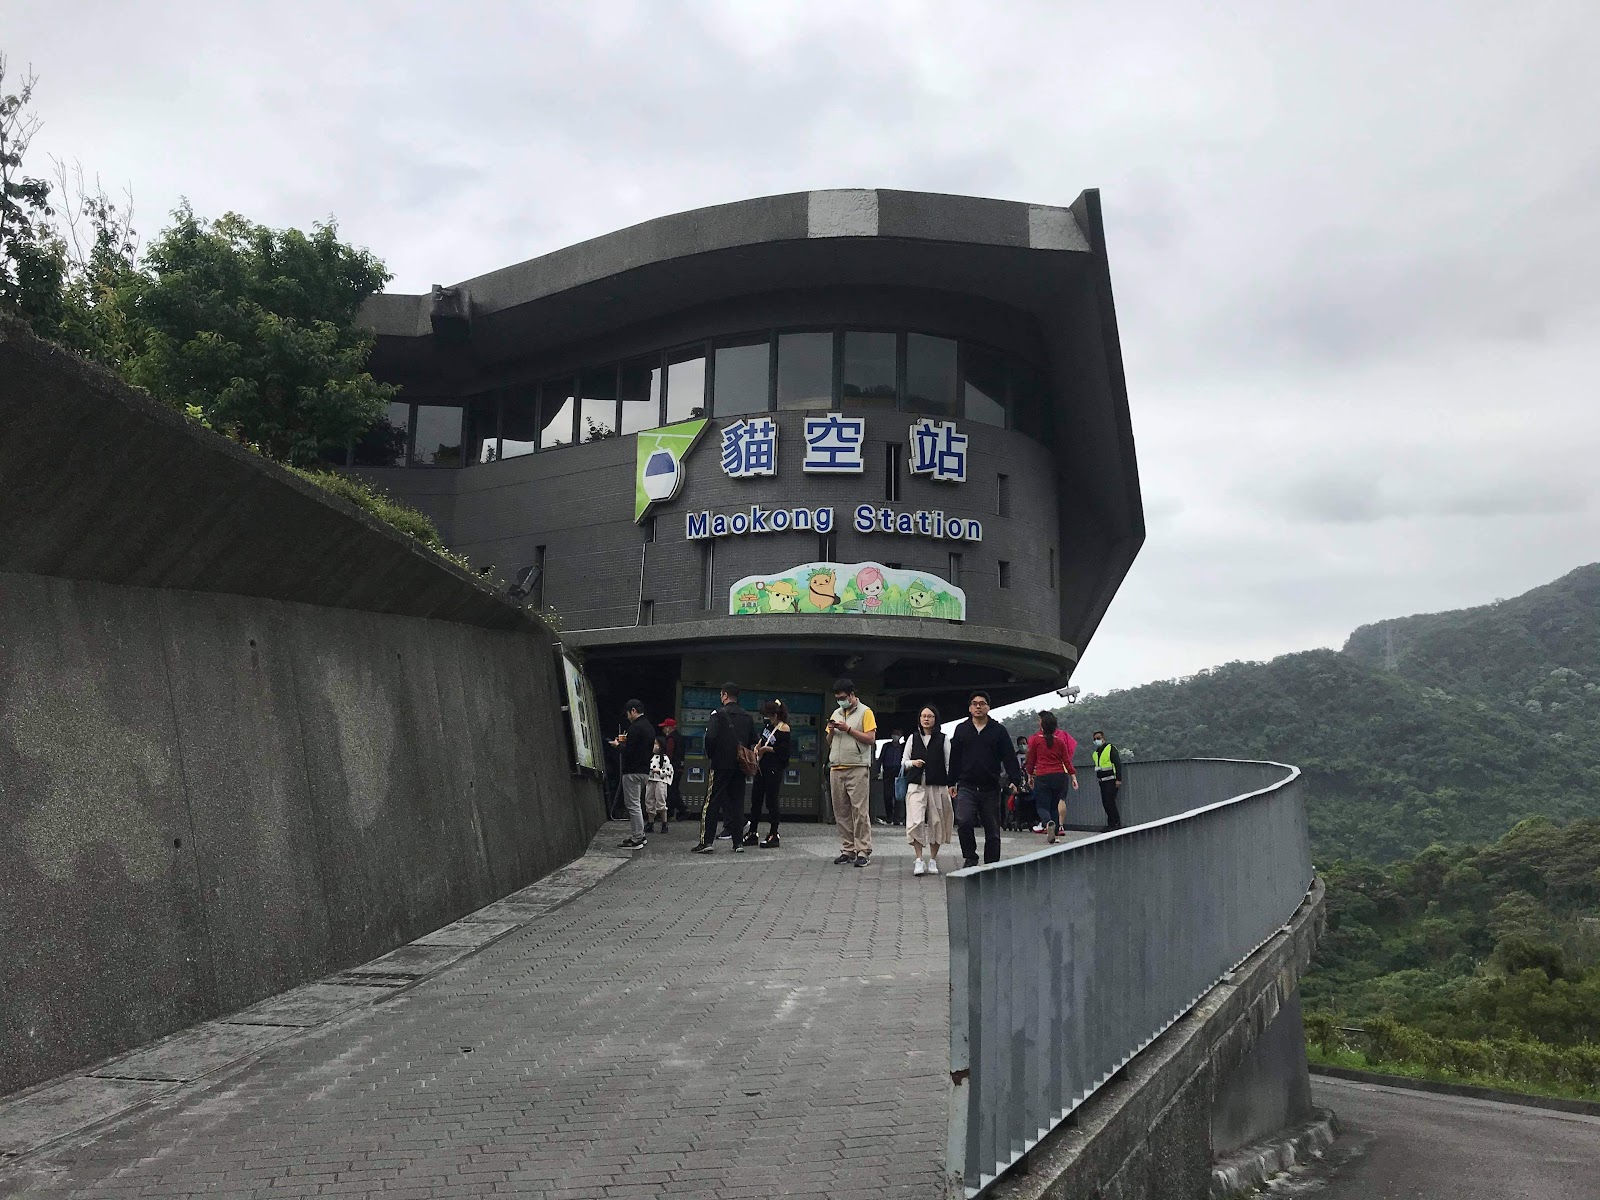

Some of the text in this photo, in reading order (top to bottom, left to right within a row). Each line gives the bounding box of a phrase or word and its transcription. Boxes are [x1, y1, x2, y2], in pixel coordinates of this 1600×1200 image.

[721, 414, 967, 480] 貓空站
[687, 505, 982, 540] Maokong Station
